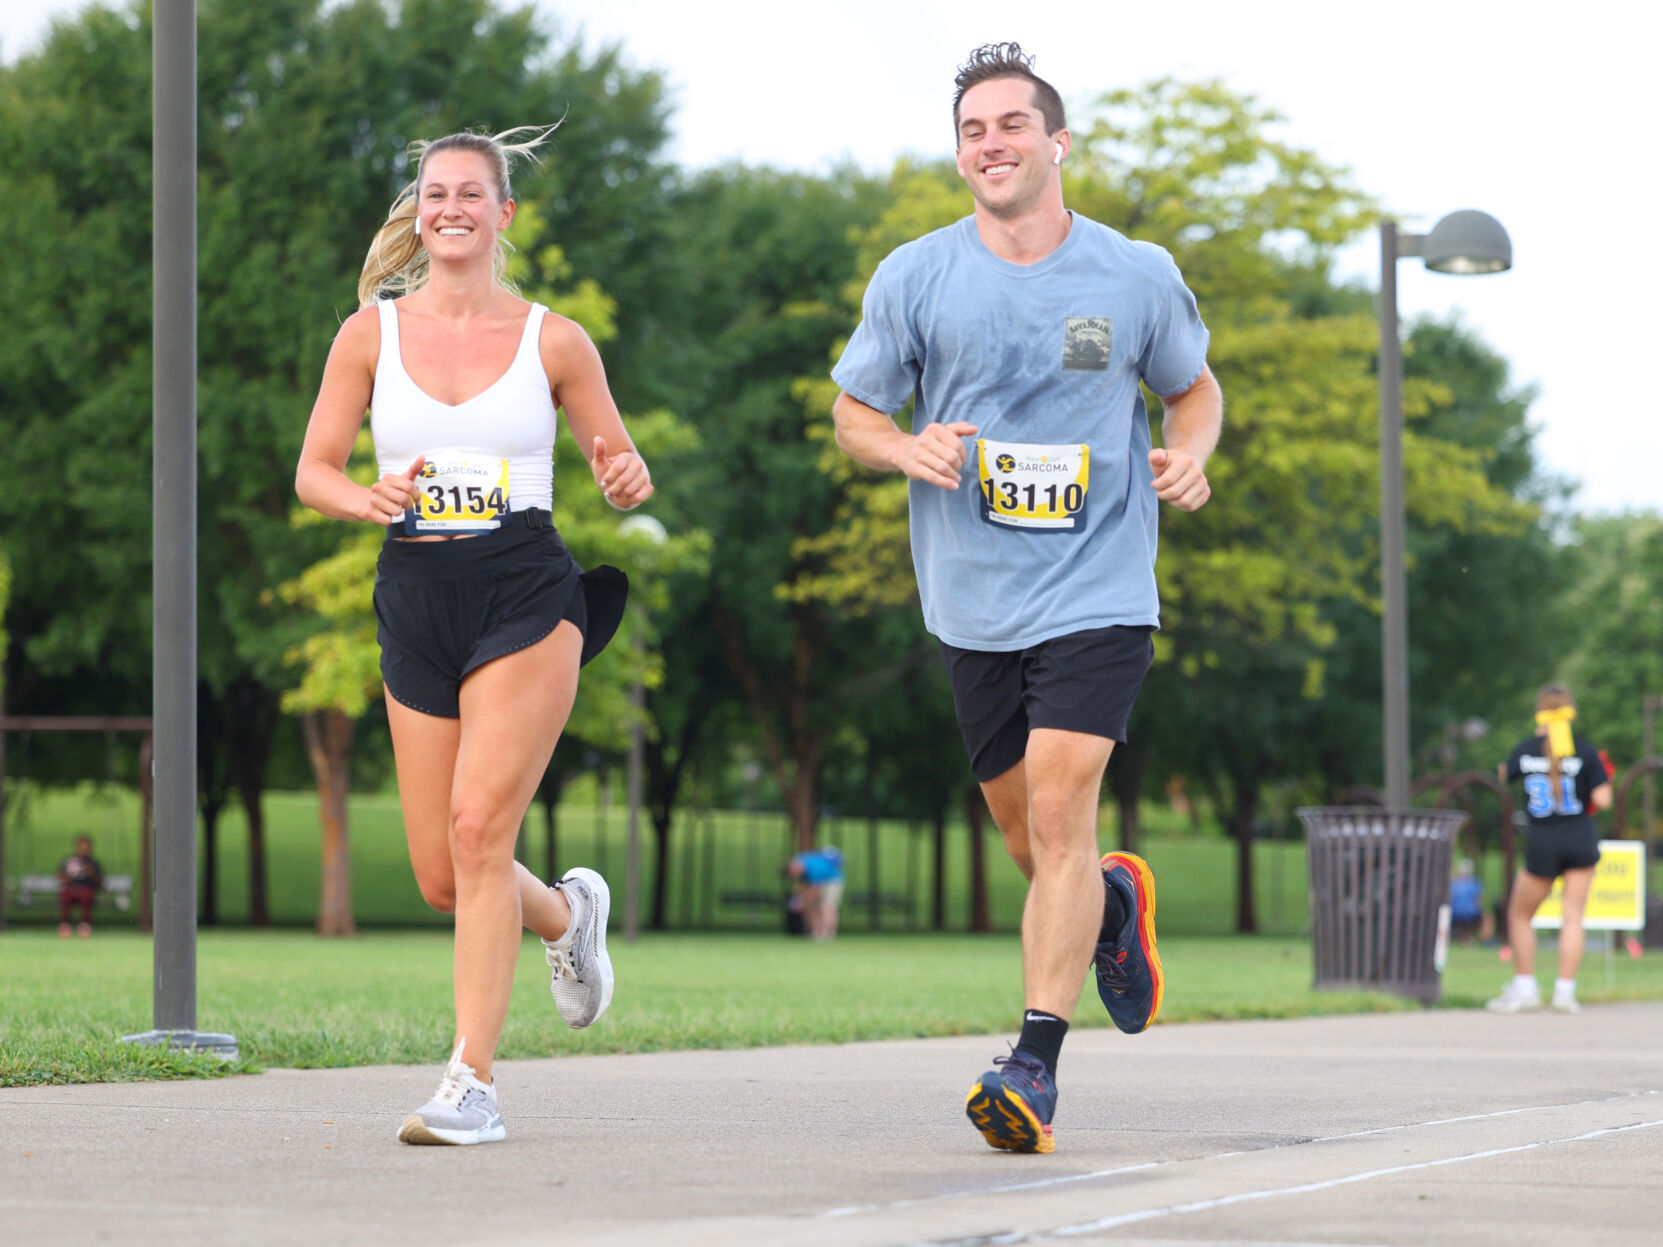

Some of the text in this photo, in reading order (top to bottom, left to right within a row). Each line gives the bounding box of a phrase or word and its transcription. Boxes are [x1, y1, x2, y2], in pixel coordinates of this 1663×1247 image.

[439, 466, 489, 476] SARCOMA
[1018, 462, 1068, 472] SARCOMA
[984, 478, 1083, 513] 13110
[1524, 773, 1583, 818] 31
